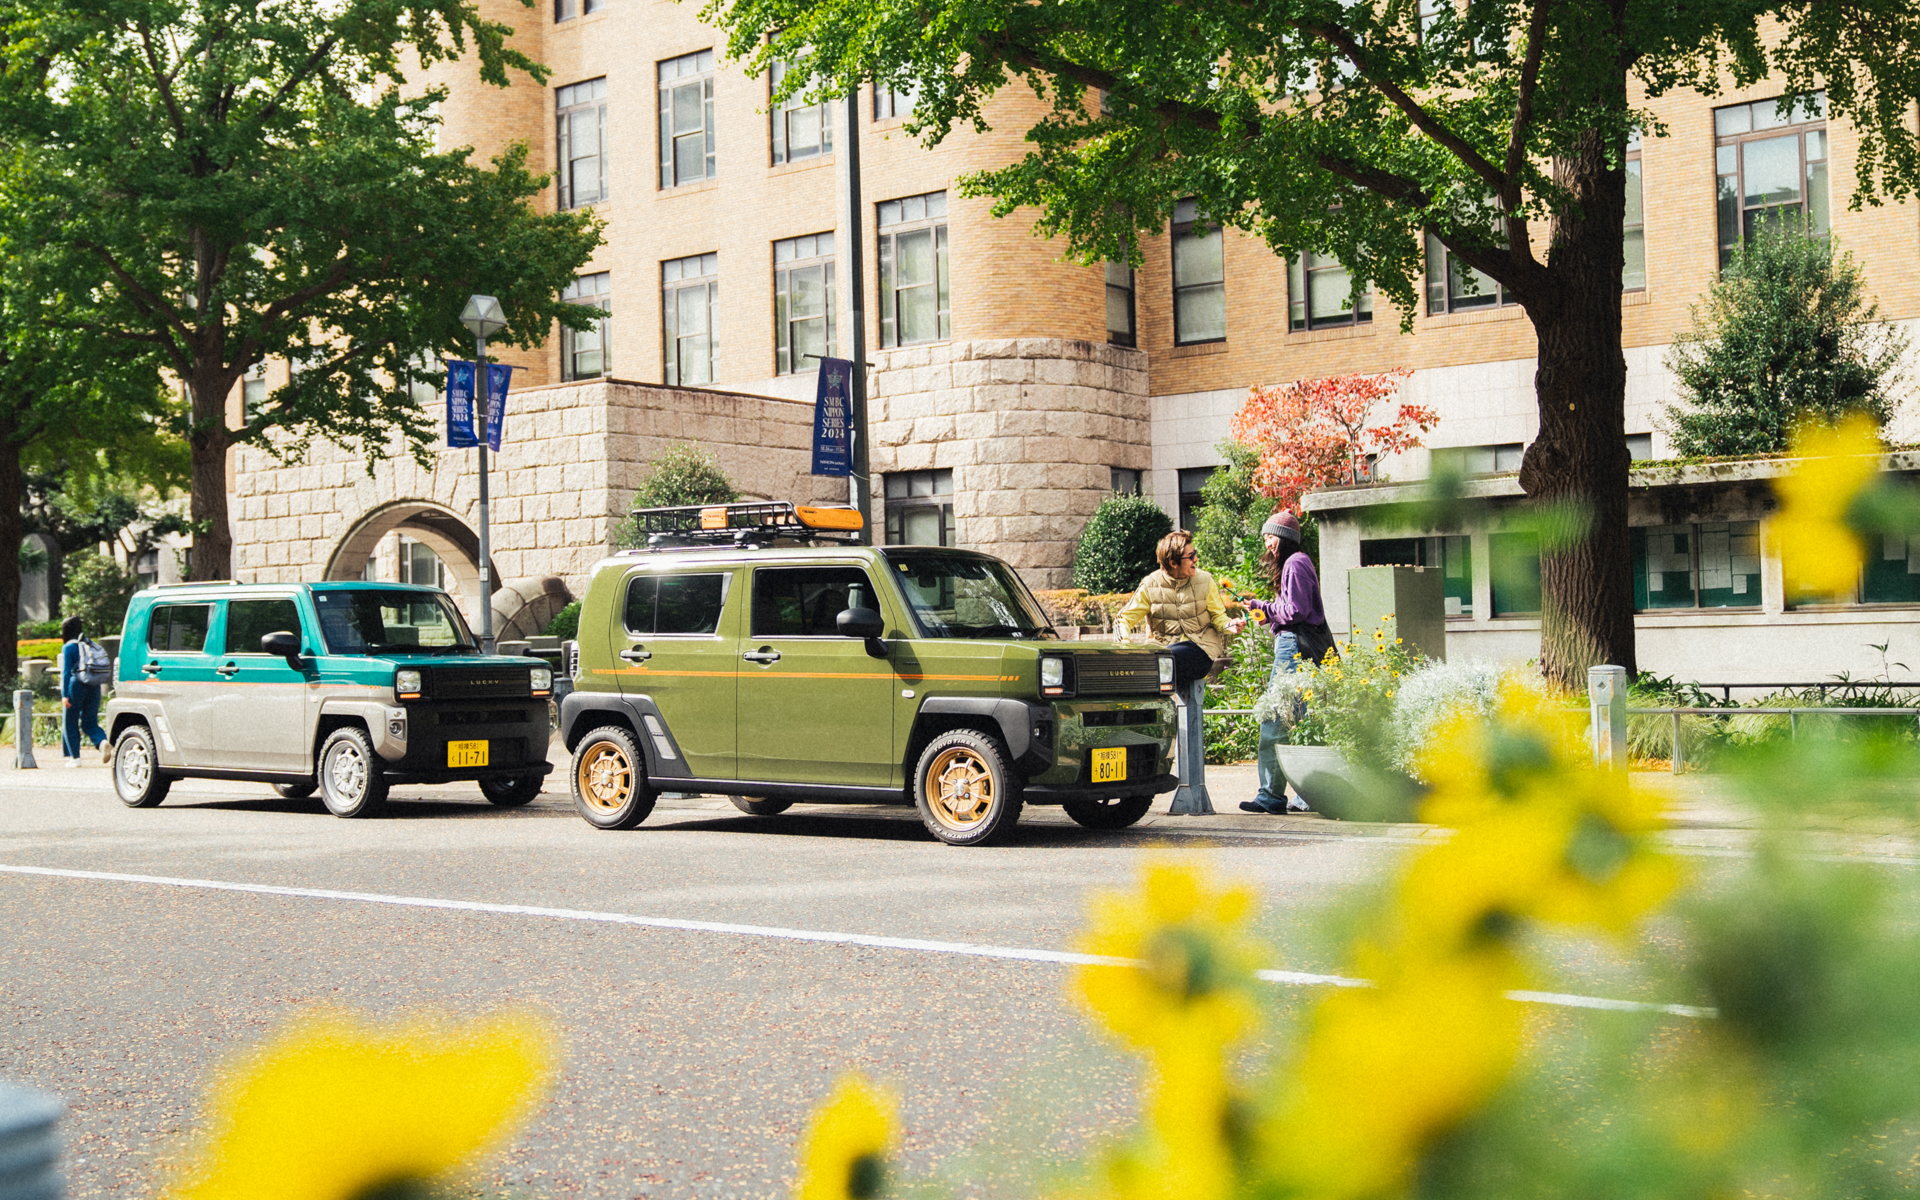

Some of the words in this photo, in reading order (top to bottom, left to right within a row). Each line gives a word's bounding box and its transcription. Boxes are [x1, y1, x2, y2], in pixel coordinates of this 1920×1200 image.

[451, 389, 468, 398] SMBC
[824, 396, 844, 407] SMBC
[452, 413, 469, 422] 2024
[823, 407, 844, 418] NIPPON
[822, 418, 844, 428] SERIES
[821, 428, 845, 439] 2024
[459, 751, 484, 765] 11-71
